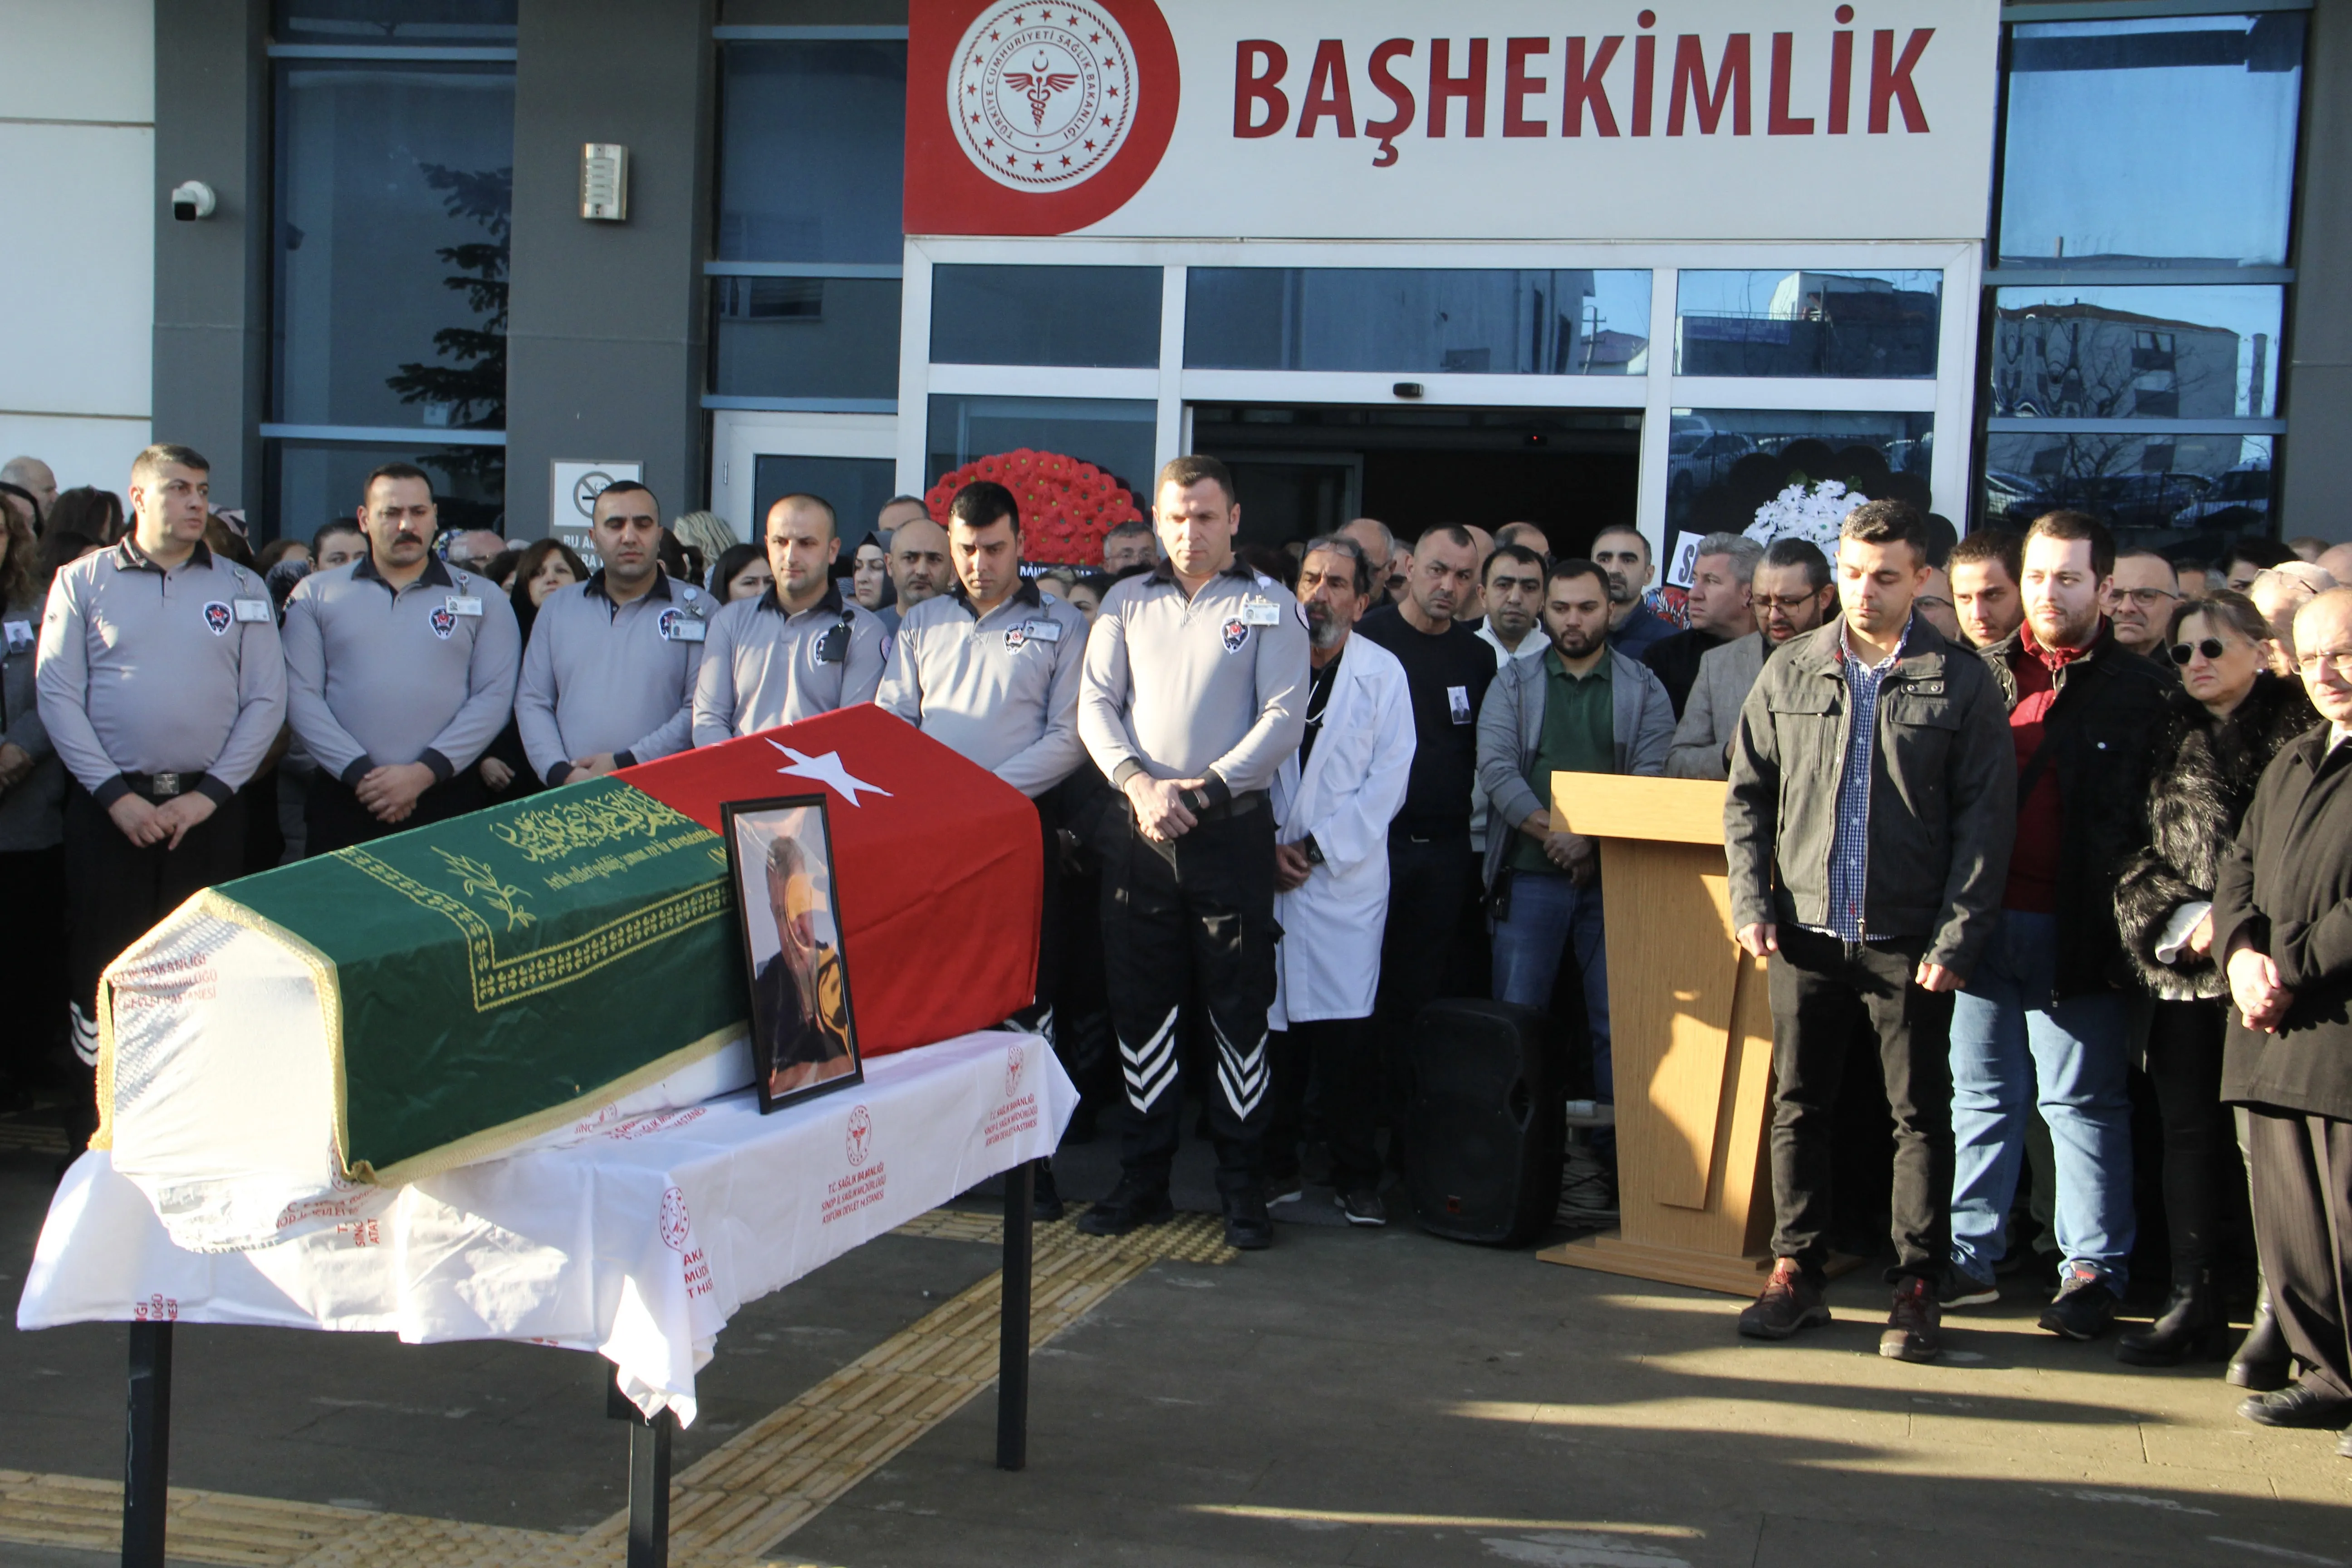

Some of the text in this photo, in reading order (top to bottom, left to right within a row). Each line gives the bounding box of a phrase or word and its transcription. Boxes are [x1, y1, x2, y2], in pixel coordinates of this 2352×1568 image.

[986, 30, 1095, 140] TÜRKİYE CUMHURİYETİ SAĞLIK BAKANLIĞI
[1233, 3, 1937, 168] BAŞHEKİMLİK
[564, 534, 578, 549] BU
[1678, 544, 1696, 583] S
[828, 1181, 837, 1195] T.C.
[838, 1174, 857, 1191] SAĞLIK
[822, 1198, 836, 1212] SİNOP
[843, 1200, 859, 1216] DEVLET
[860, 1187, 884, 1209] HSTANESİ
